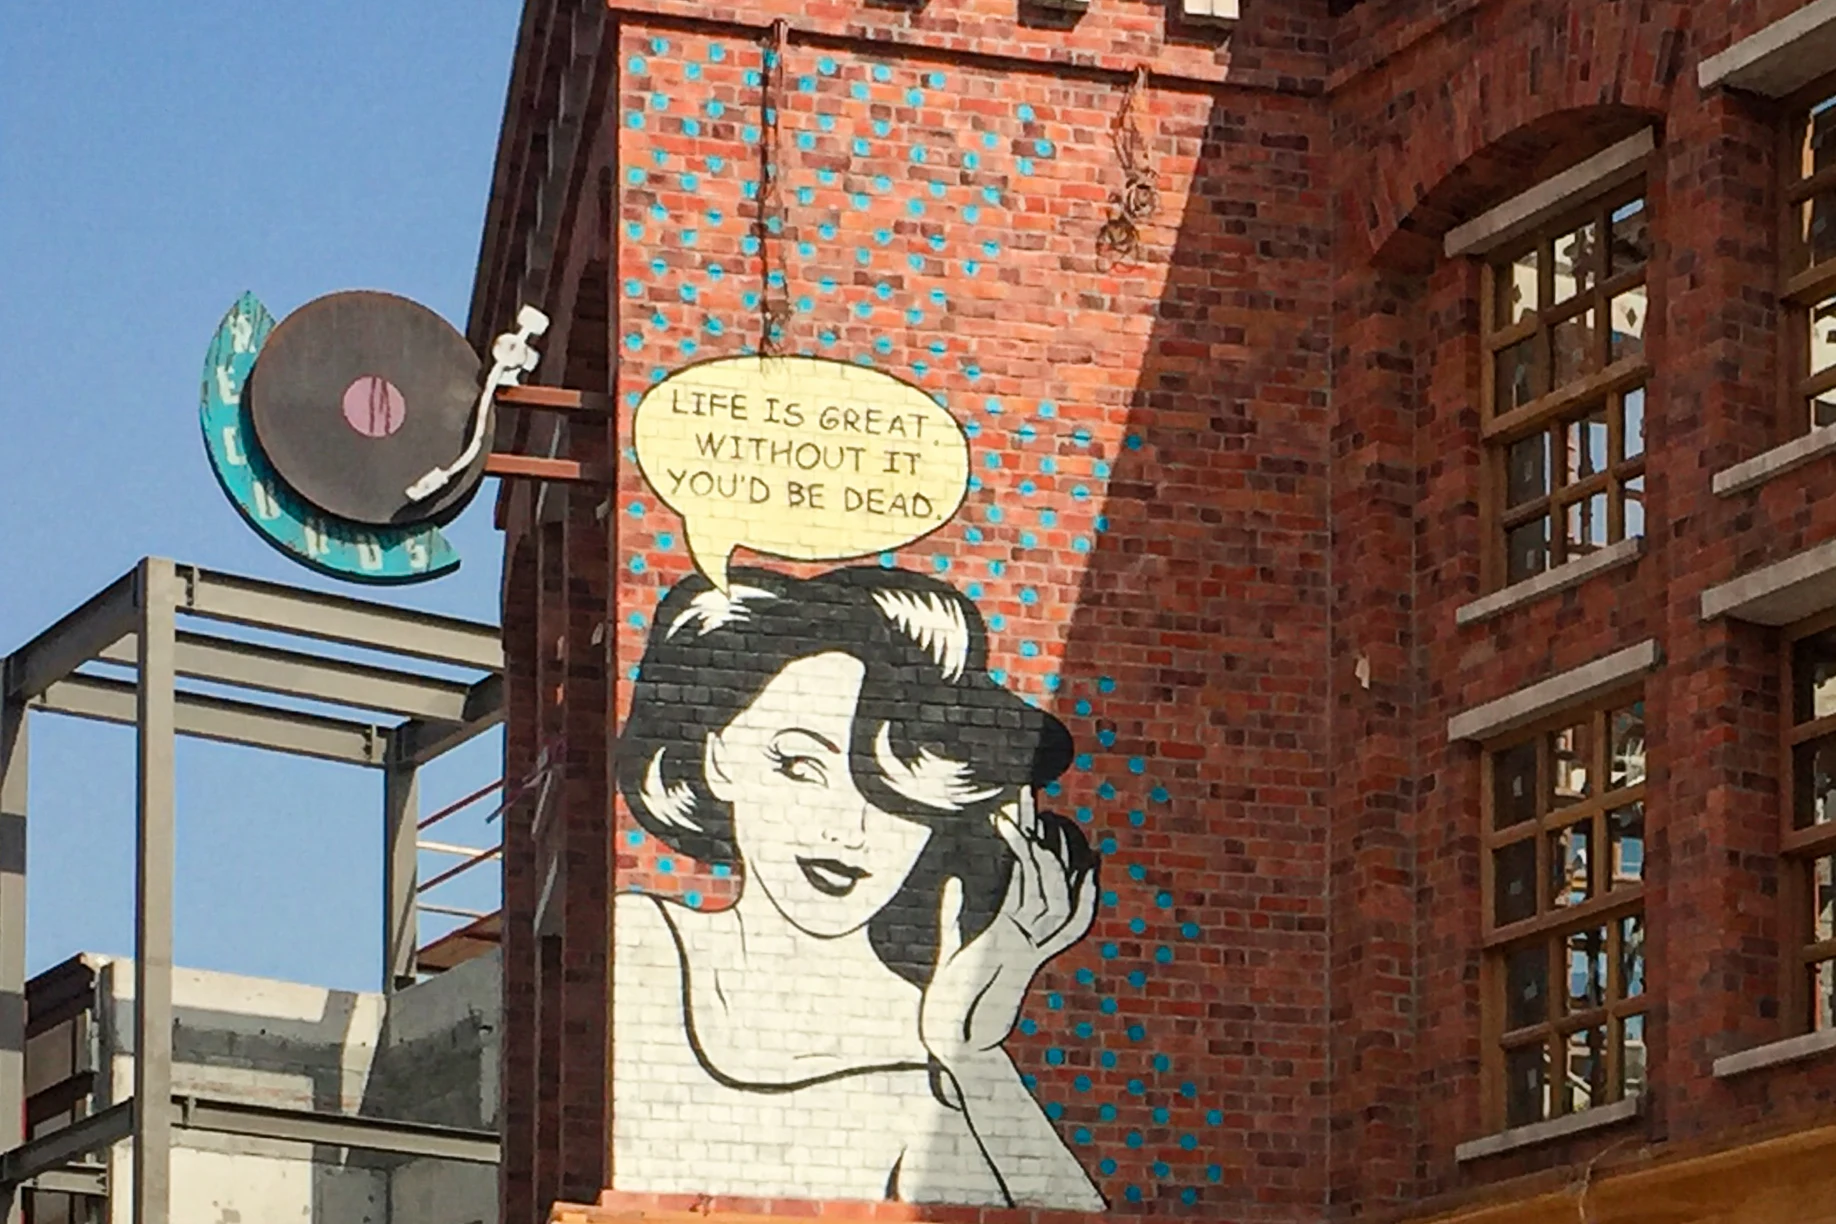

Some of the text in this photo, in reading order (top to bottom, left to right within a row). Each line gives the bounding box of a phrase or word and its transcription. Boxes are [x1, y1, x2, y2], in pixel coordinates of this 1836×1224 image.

[672, 389, 748, 421] LIFE
[764, 398, 804, 427] IS
[695, 432, 921, 475] WITHOUT IT
[667, 468, 942, 520] YOU'D BE DEAD.
